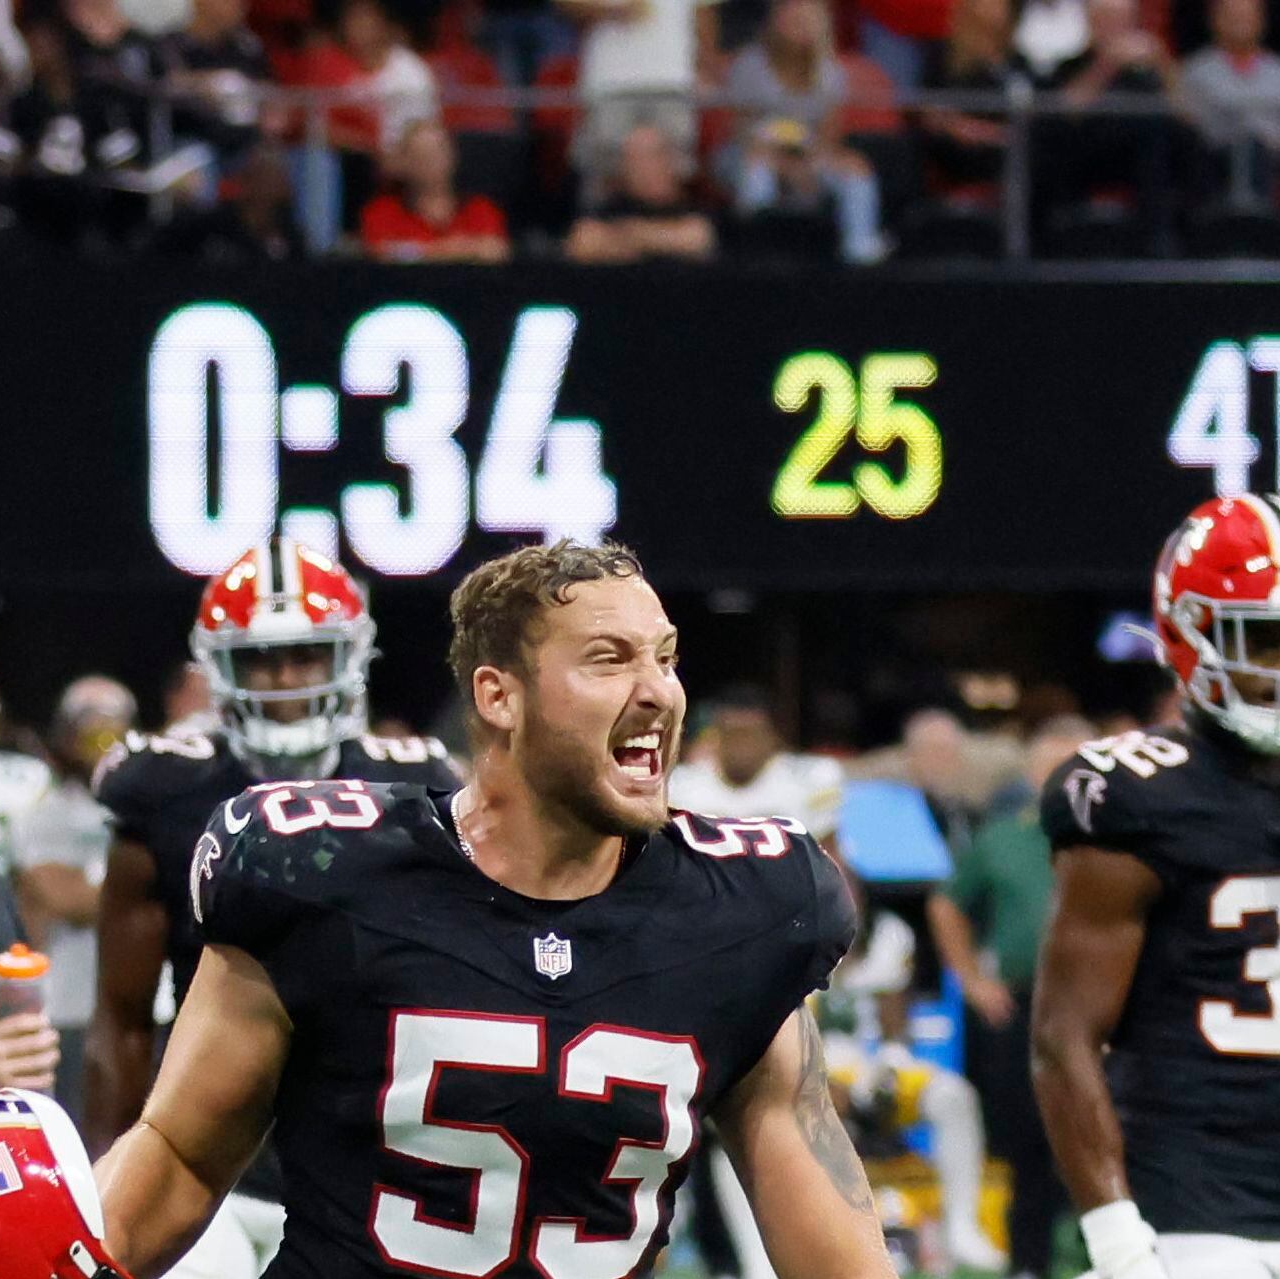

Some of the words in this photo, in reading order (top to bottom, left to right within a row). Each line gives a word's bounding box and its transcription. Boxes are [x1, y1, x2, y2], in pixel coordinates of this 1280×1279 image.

[148, 303, 618, 575] 0:34
[772, 351, 942, 520] 25
[541, 953, 568, 972] NFL
